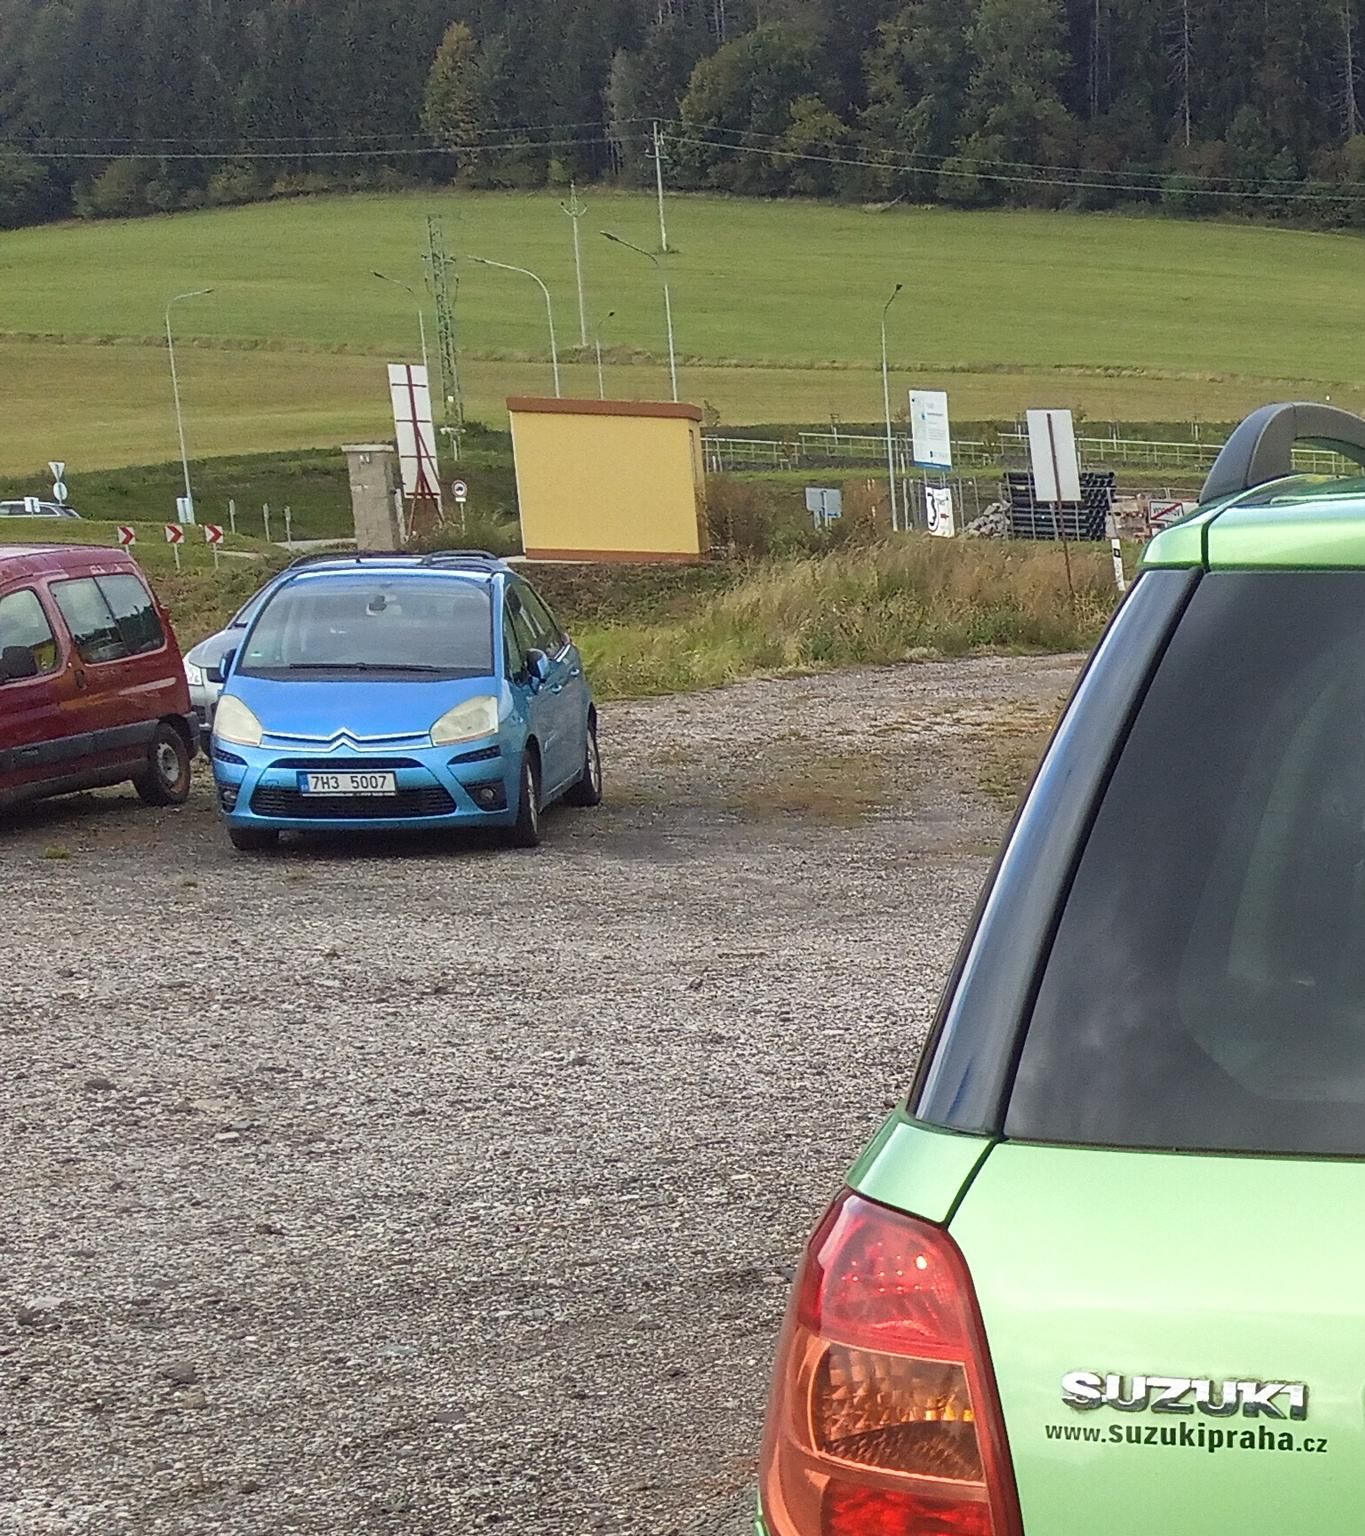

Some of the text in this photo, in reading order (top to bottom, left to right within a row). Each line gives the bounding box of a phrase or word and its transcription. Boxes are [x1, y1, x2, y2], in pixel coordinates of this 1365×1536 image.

[310, 775, 340, 790] 7H3
[350, 775, 387, 790] 5007
[1060, 1370, 1310, 1421] SUZUKI
[1045, 1421, 1329, 1454] www.suzukipraha.cz
